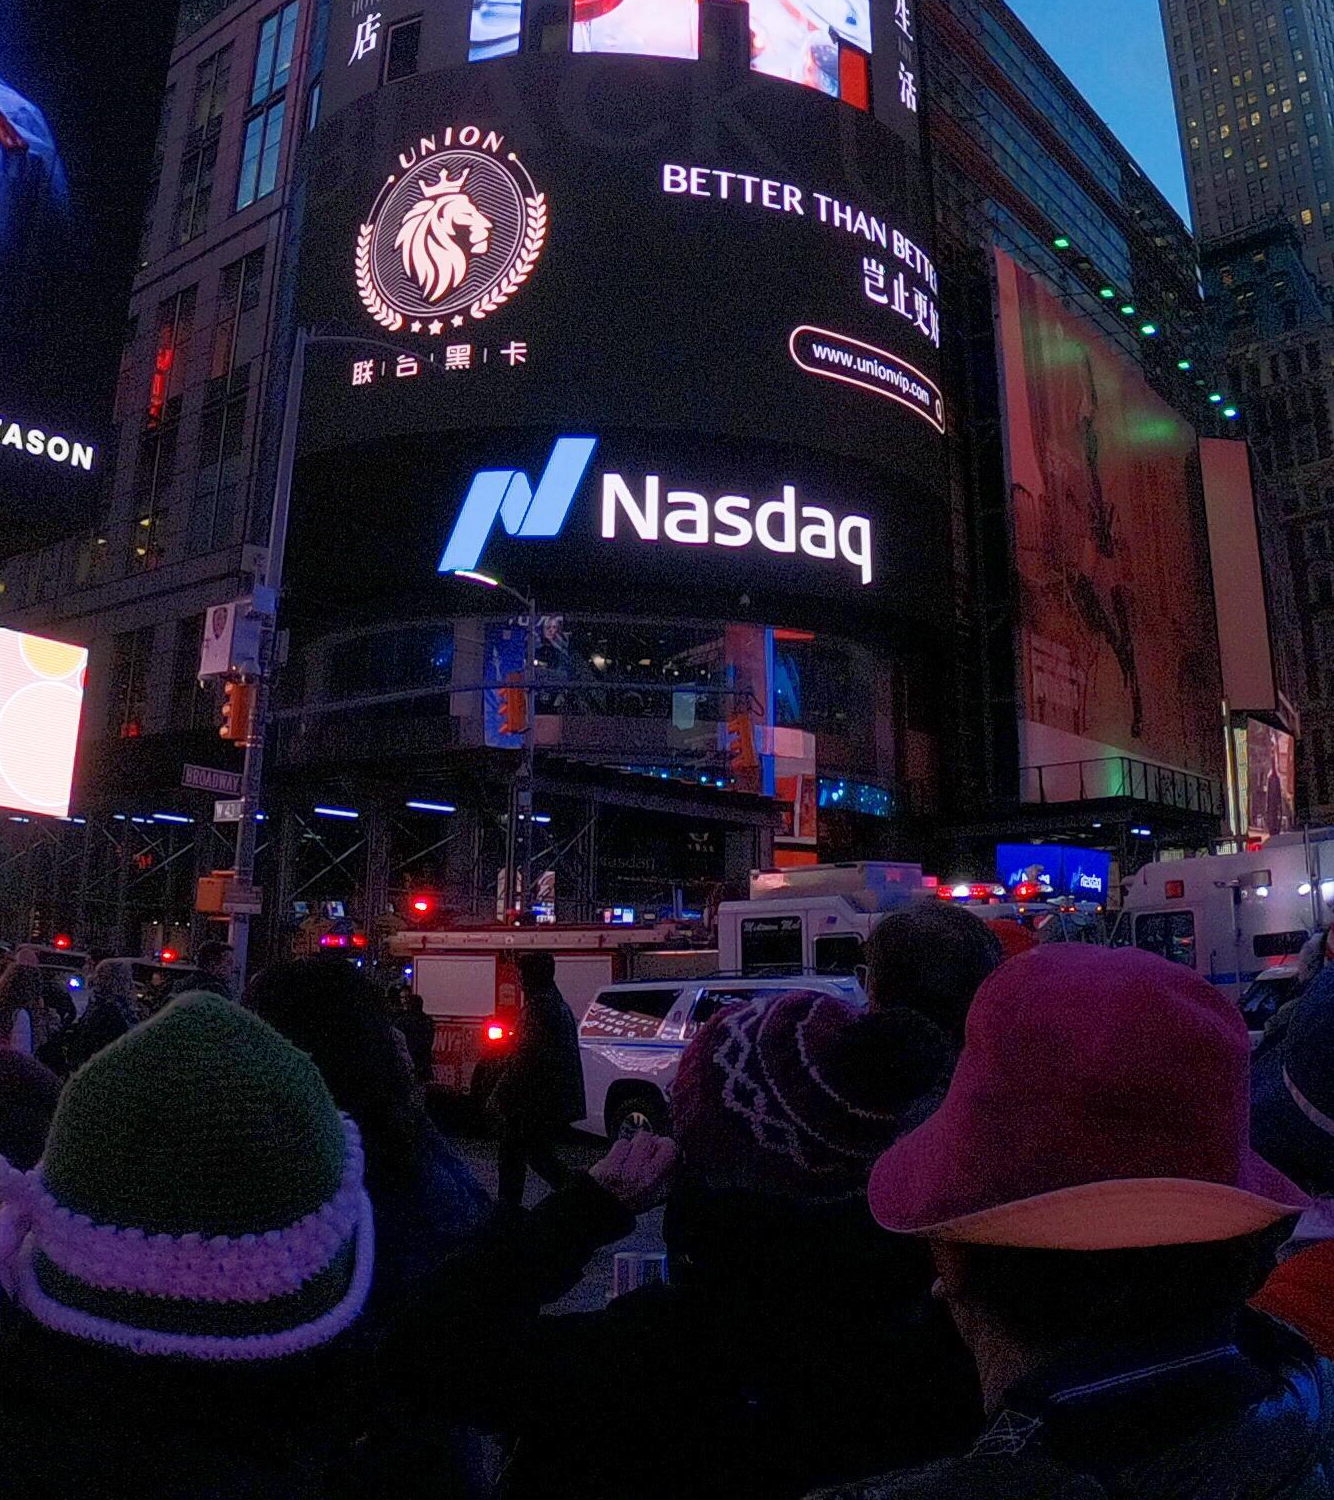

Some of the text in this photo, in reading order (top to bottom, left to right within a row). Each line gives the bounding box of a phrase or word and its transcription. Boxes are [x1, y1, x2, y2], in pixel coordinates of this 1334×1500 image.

[398, 125, 505, 169] UNION
[663, 164, 804, 215] BETTER
[812, 192, 887, 248] THAN
[812, 343, 930, 406] www.unionvip.com
[601, 473, 873, 584] Nasdaq
[185, 766, 241, 793] BROADWAY
